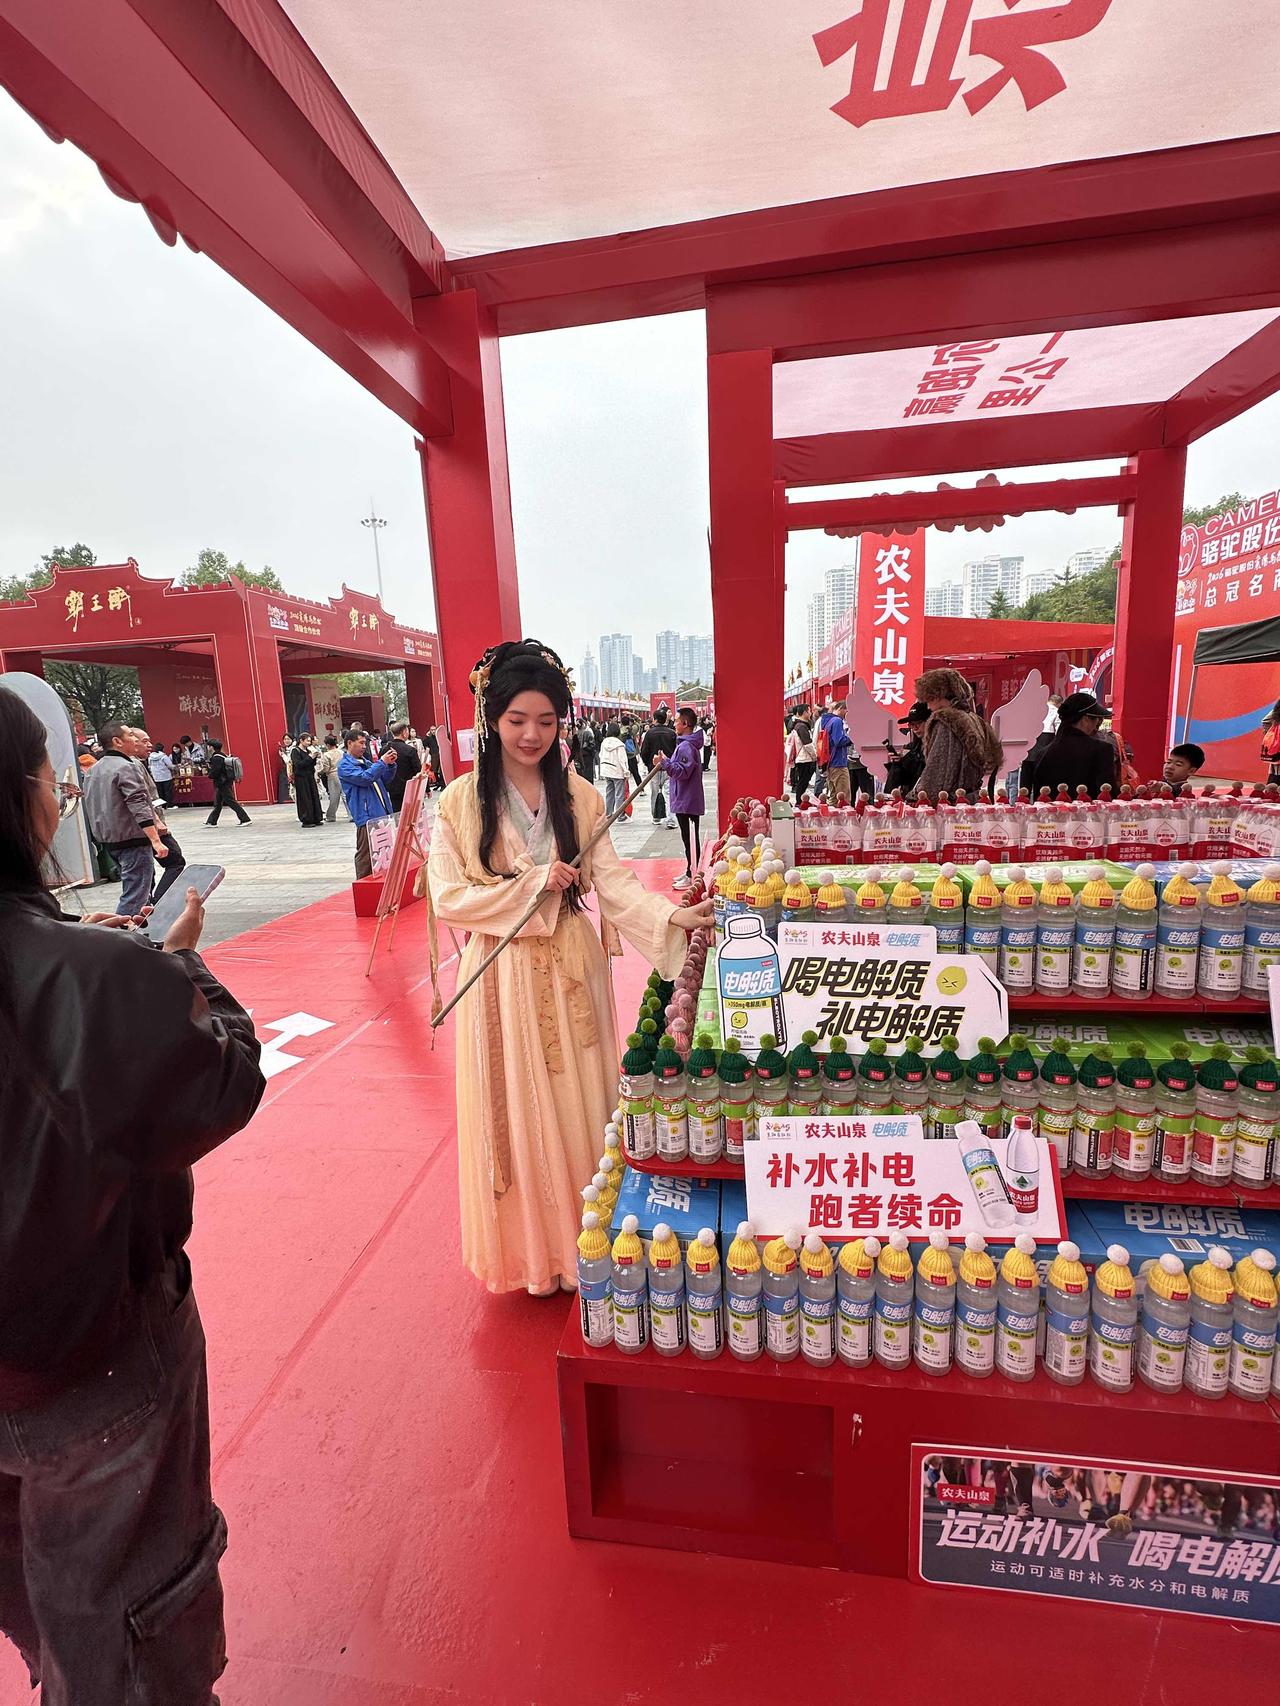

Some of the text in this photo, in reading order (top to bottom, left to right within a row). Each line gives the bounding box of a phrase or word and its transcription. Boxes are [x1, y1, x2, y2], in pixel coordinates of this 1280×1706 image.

[872, 543, 913, 705] 农夫山泉
[821, 930, 881, 947] 农夫山泉
[886, 931, 922, 948] 电解质
[724, 967, 776, 998] 电解质
[780, 956, 932, 1001] 喝电解质
[815, 1001, 967, 1046] 补电解质
[804, 1122, 867, 1139] 农夫山泉
[872, 1121, 909, 1138] 电解质
[766, 1151, 917, 1188] 补水补电
[808, 1193, 964, 1230] 跑者续命
[1124, 1202, 1250, 1240] 电解质
[941, 1487, 990, 1502] 农夫山泉
[936, 1509, 1111, 1563] 运动补水
[990, 1559, 1250, 1605] 运动可适时补充水分和电解质
